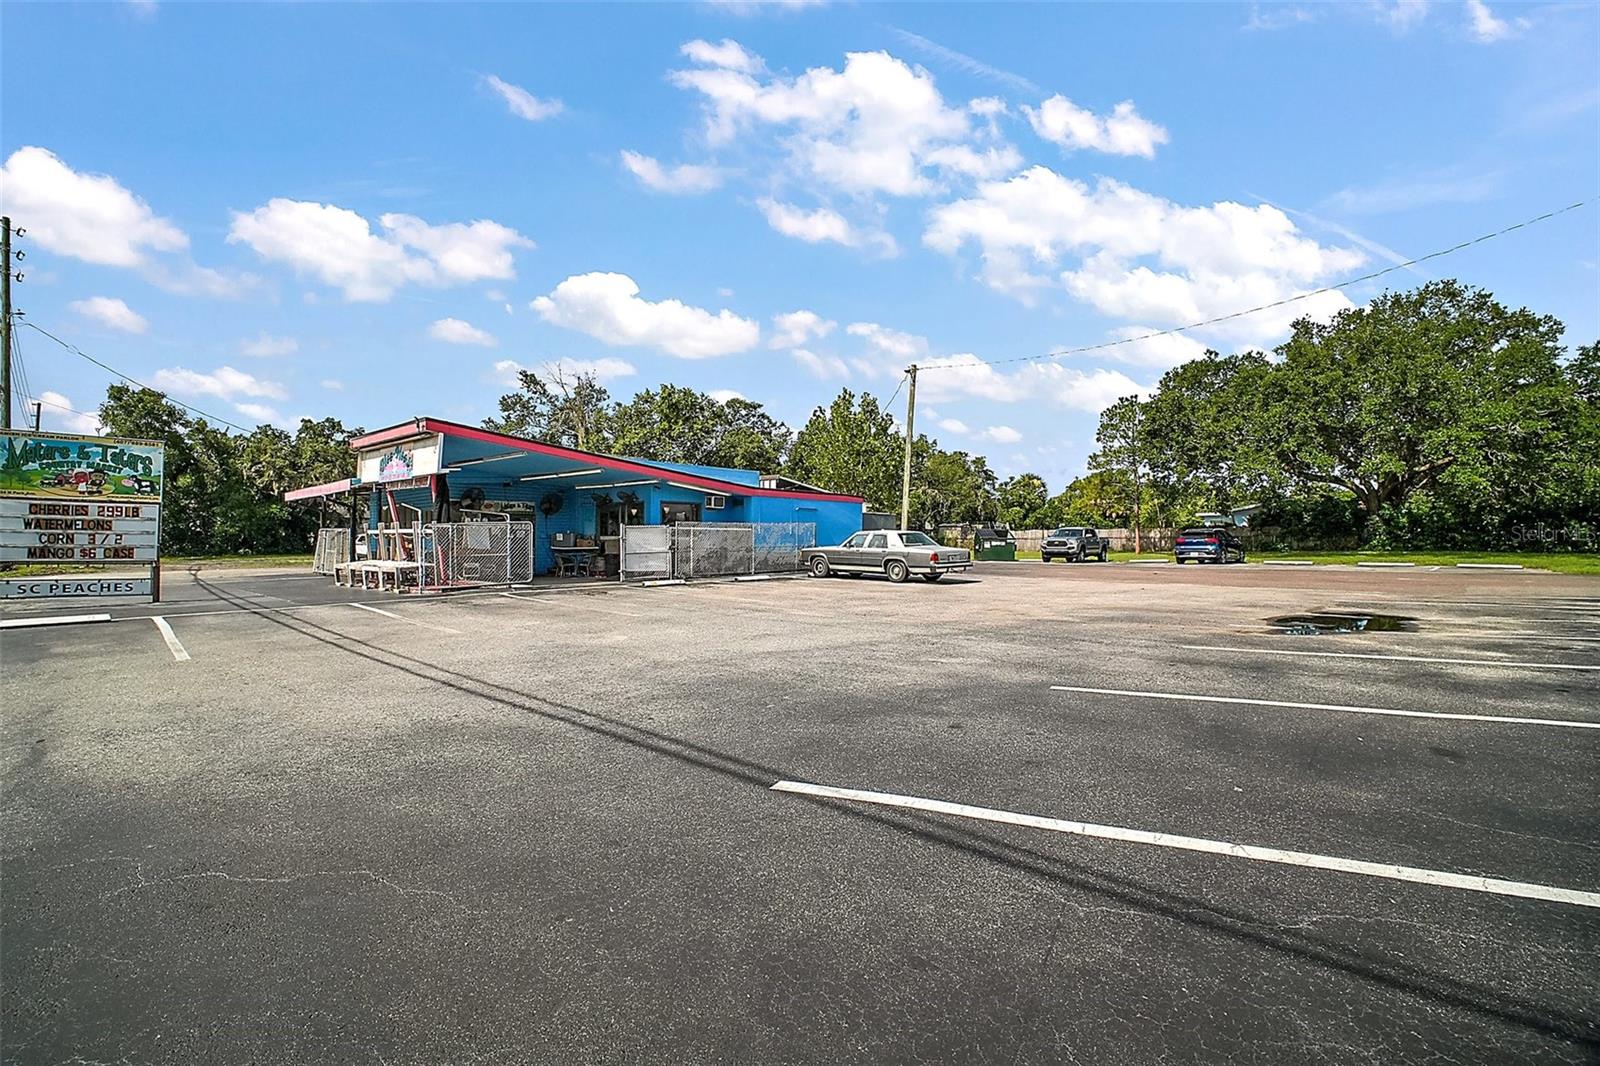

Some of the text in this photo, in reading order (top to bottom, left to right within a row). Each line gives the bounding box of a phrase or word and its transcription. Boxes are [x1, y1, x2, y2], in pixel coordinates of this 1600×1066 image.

[4, 437, 153, 476] Maters & Taters
[29, 504, 89, 515] CHERRIES
[23, 518, 112, 530] WATERMELONS
[38, 533, 74, 544] CORN
[27, 548, 74, 559] MANGO
[80, 548, 97, 558] $6
[17, 583, 133, 594] SC PEACHES
